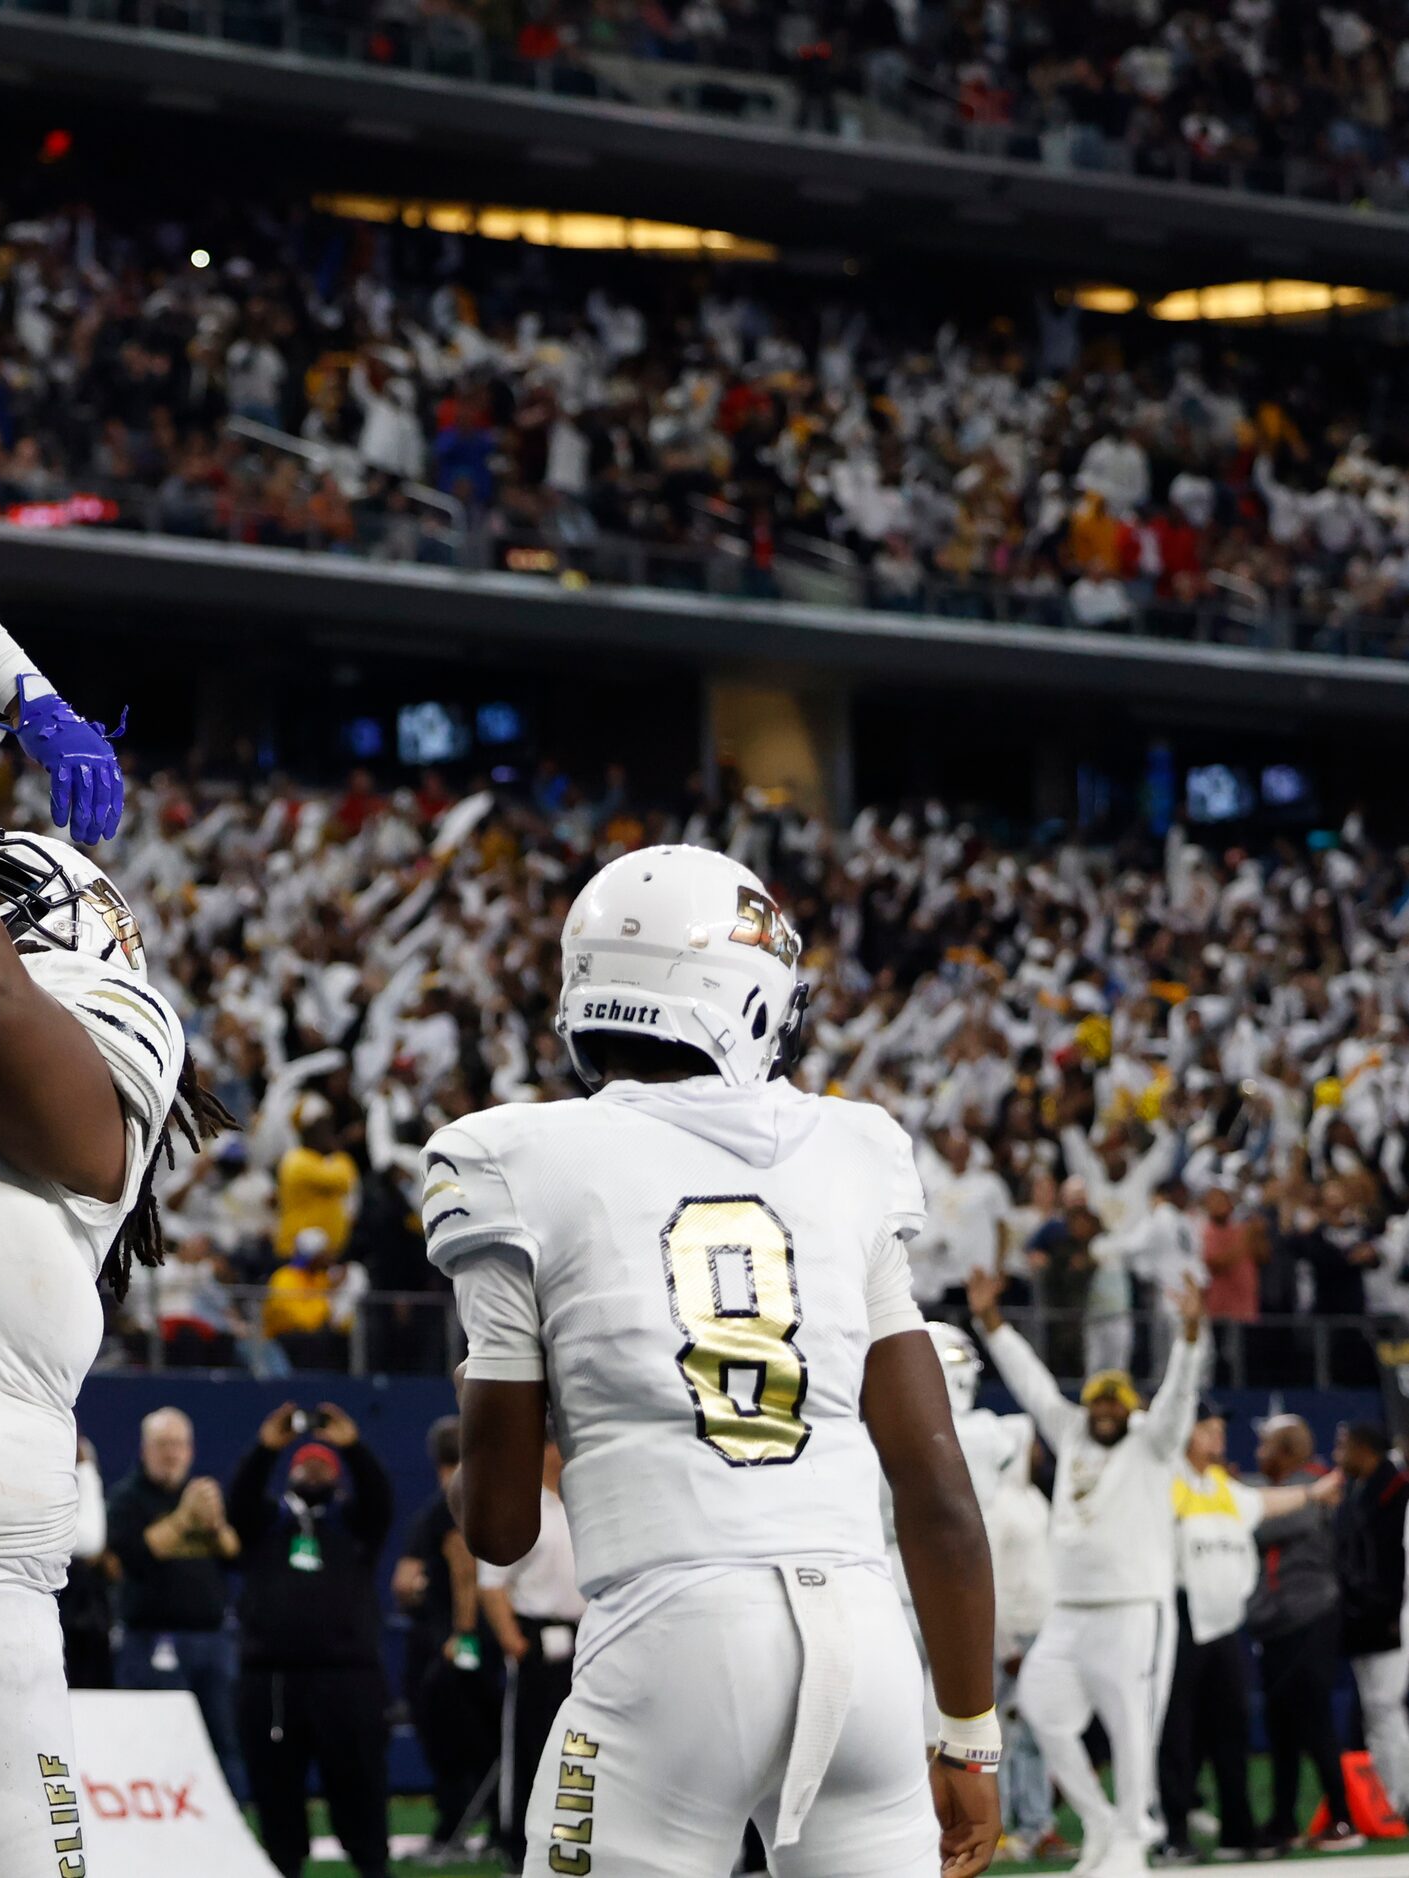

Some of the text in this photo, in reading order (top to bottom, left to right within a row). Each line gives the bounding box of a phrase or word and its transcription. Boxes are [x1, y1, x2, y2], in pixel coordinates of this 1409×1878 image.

[583, 999, 661, 1025] schutt
[658, 1193, 813, 1468] 8
[37, 1753, 86, 1878] CLIFF
[81, 1771, 208, 1821] box
[549, 1728, 600, 1876] CLIFF
